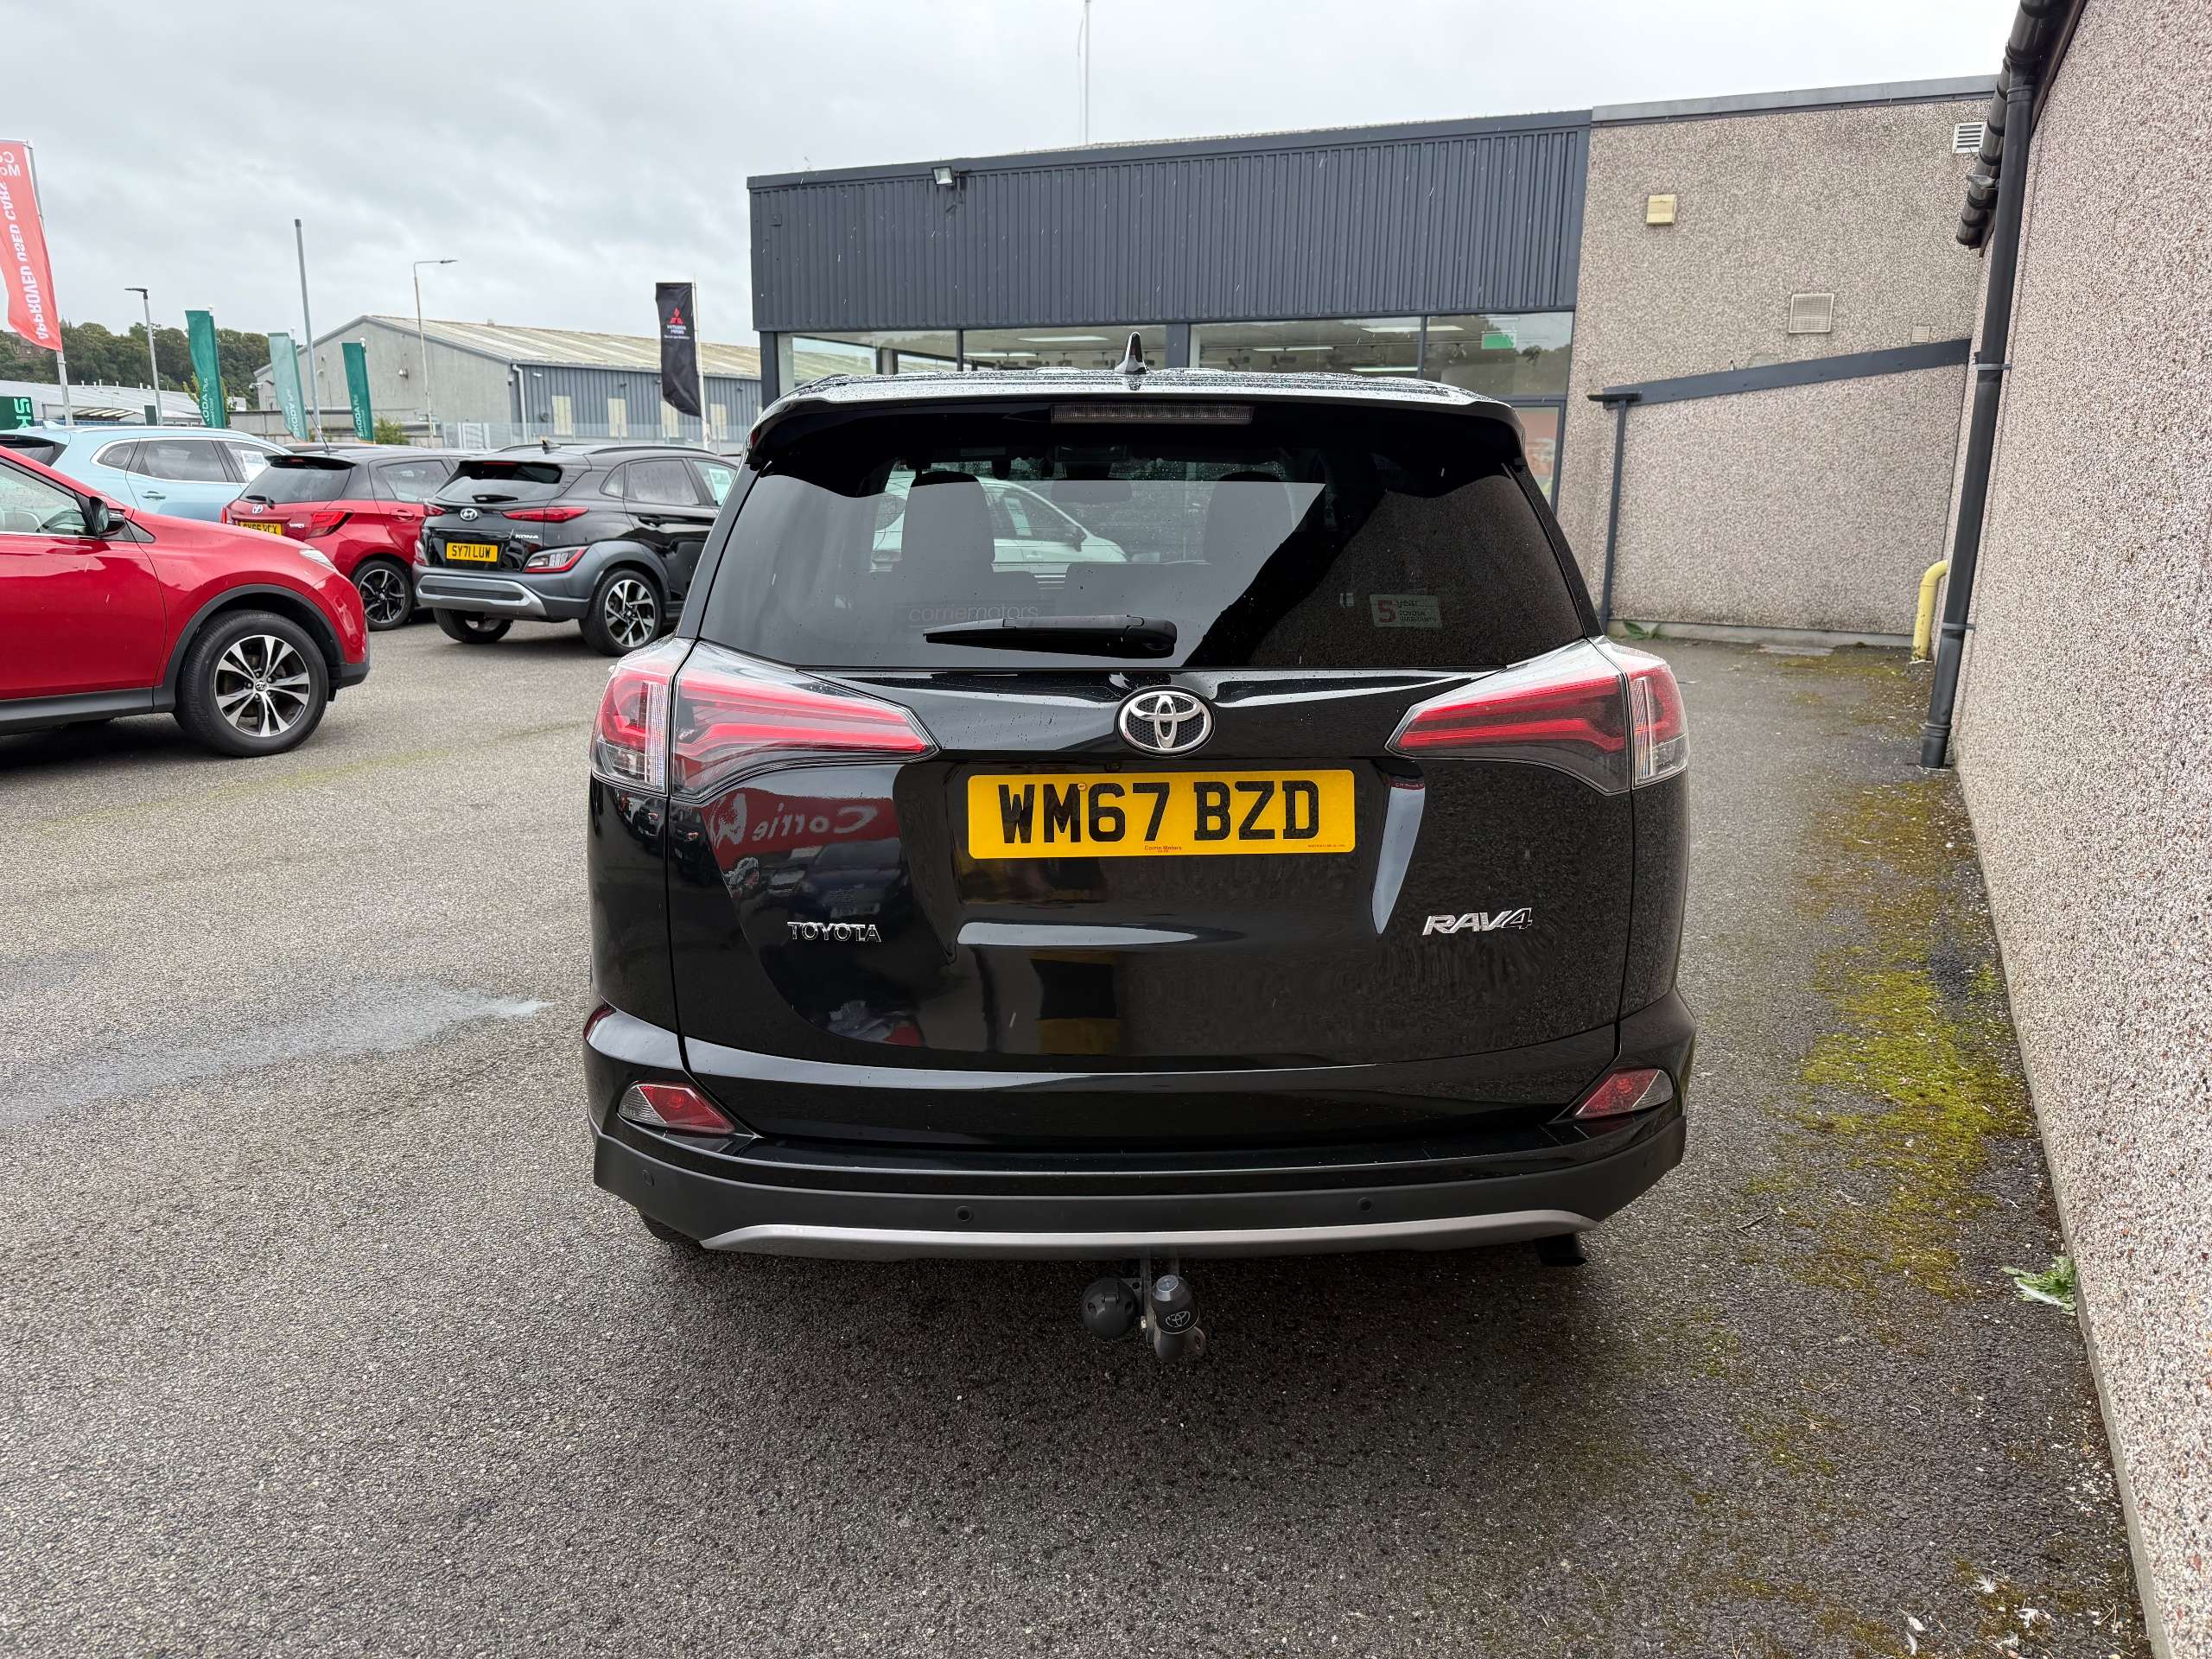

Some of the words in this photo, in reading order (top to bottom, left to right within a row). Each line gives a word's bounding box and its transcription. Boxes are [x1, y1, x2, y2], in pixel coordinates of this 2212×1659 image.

[452, 545, 471, 557] SY71
[473, 545, 491, 558] LUW
[998, 781, 1171, 844] WM67
[1193, 779, 1319, 841] BZD
[787, 921, 881, 943] TOYOTA
[1422, 907, 1533, 936] RAV4
